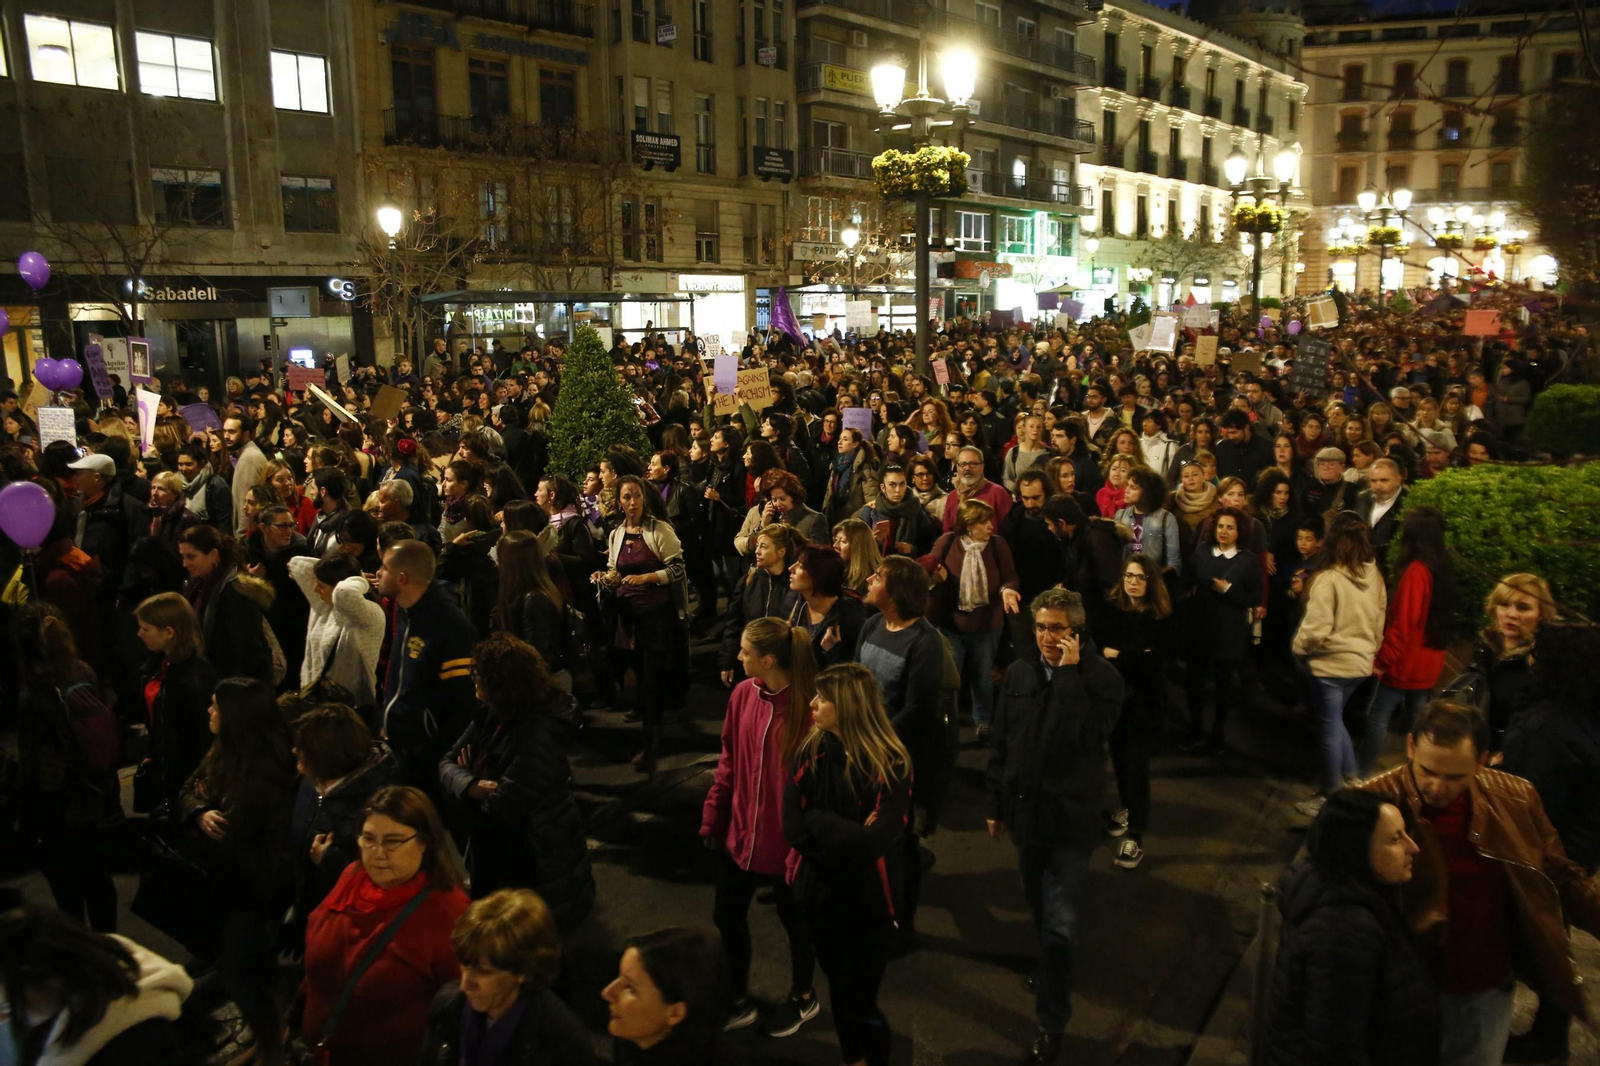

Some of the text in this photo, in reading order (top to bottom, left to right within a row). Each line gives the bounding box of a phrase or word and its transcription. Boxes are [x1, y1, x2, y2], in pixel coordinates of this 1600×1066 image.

[635, 134, 678, 147] SOLIMAN AHMED
[143, 286, 217, 301] Sabadell
[737, 371, 768, 386] AGAINST
[714, 394, 731, 408] THE
